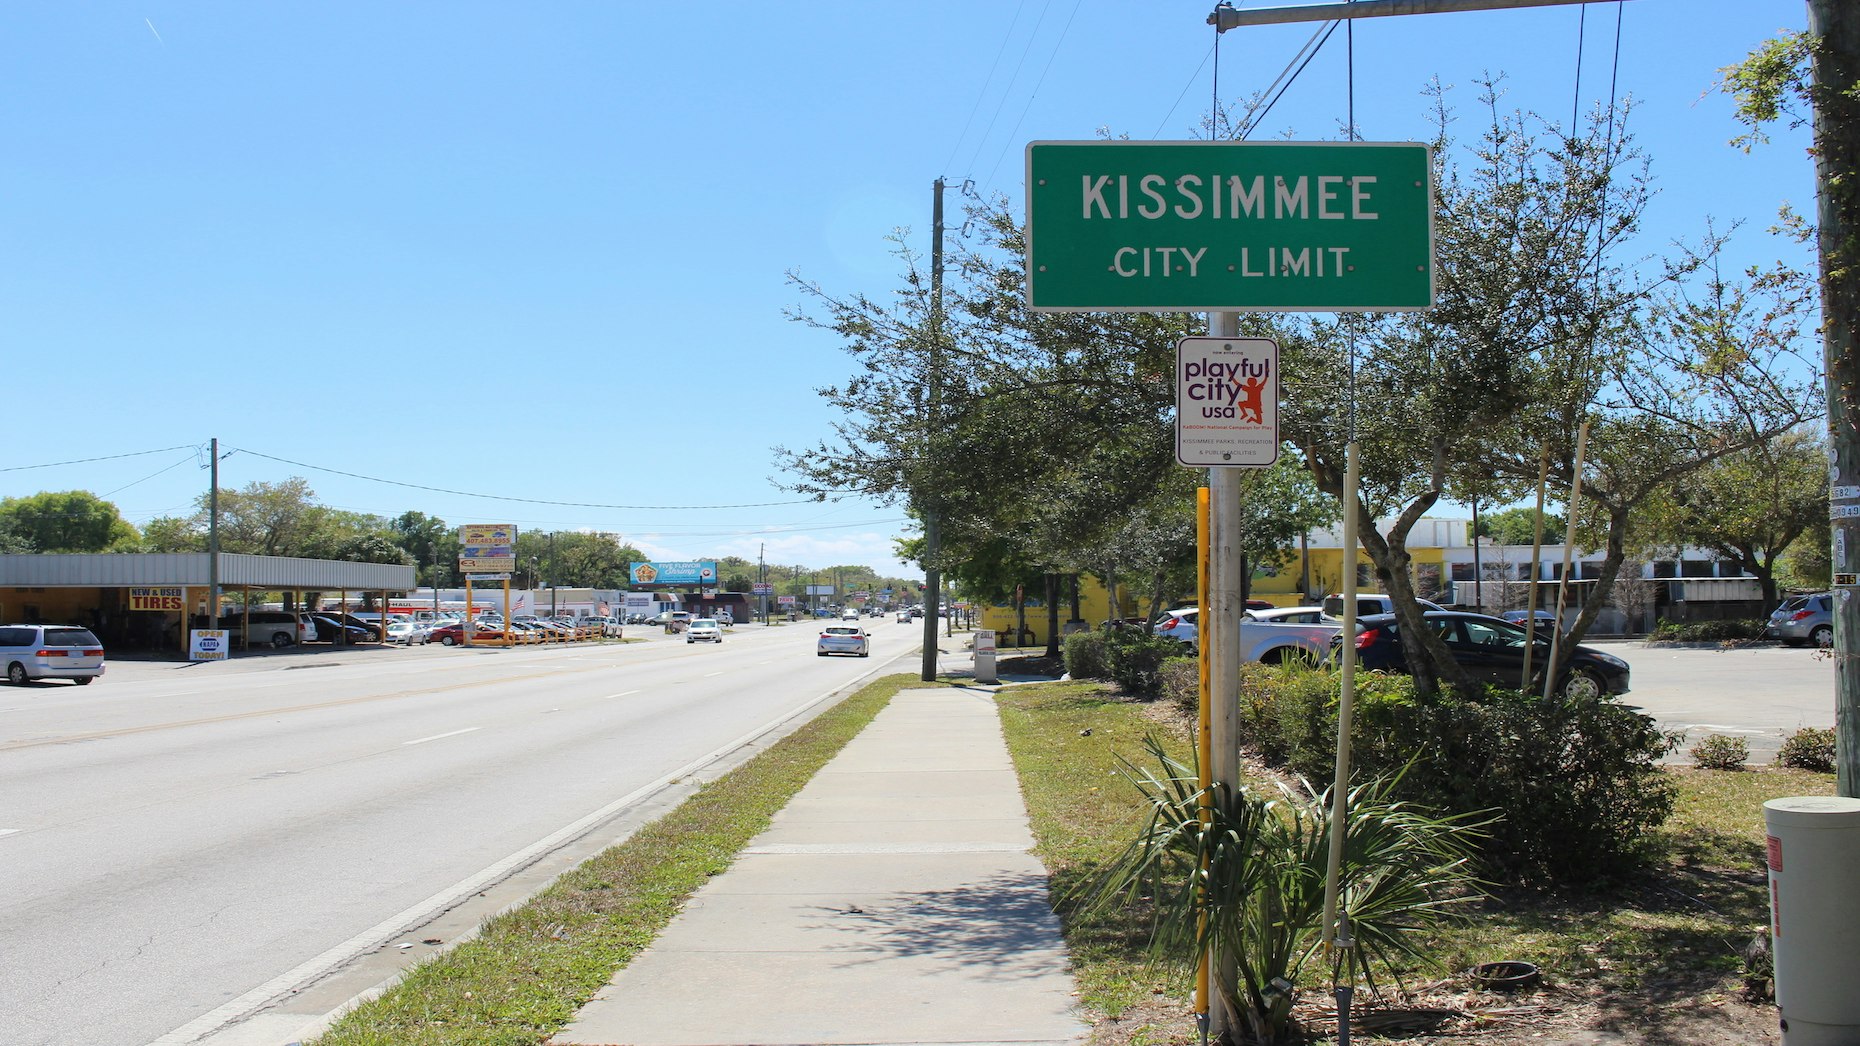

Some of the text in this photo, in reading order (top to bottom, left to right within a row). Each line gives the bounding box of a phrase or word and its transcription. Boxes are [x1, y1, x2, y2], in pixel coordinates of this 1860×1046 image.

[1082, 174, 1379, 220] KISSIMMEE
[1113, 246, 1350, 278] CITY LIMIT
[1185, 357, 1269, 382] playful
[1187, 377, 1243, 406] city
[1202, 406, 1235, 418] usa
[665, 568, 695, 576] Shrimp
[131, 588, 182, 596] NEW & USED
[132, 596, 182, 610] TIRES
[196, 630, 224, 638] OPEN
[193, 651, 225, 659] TODAY!
